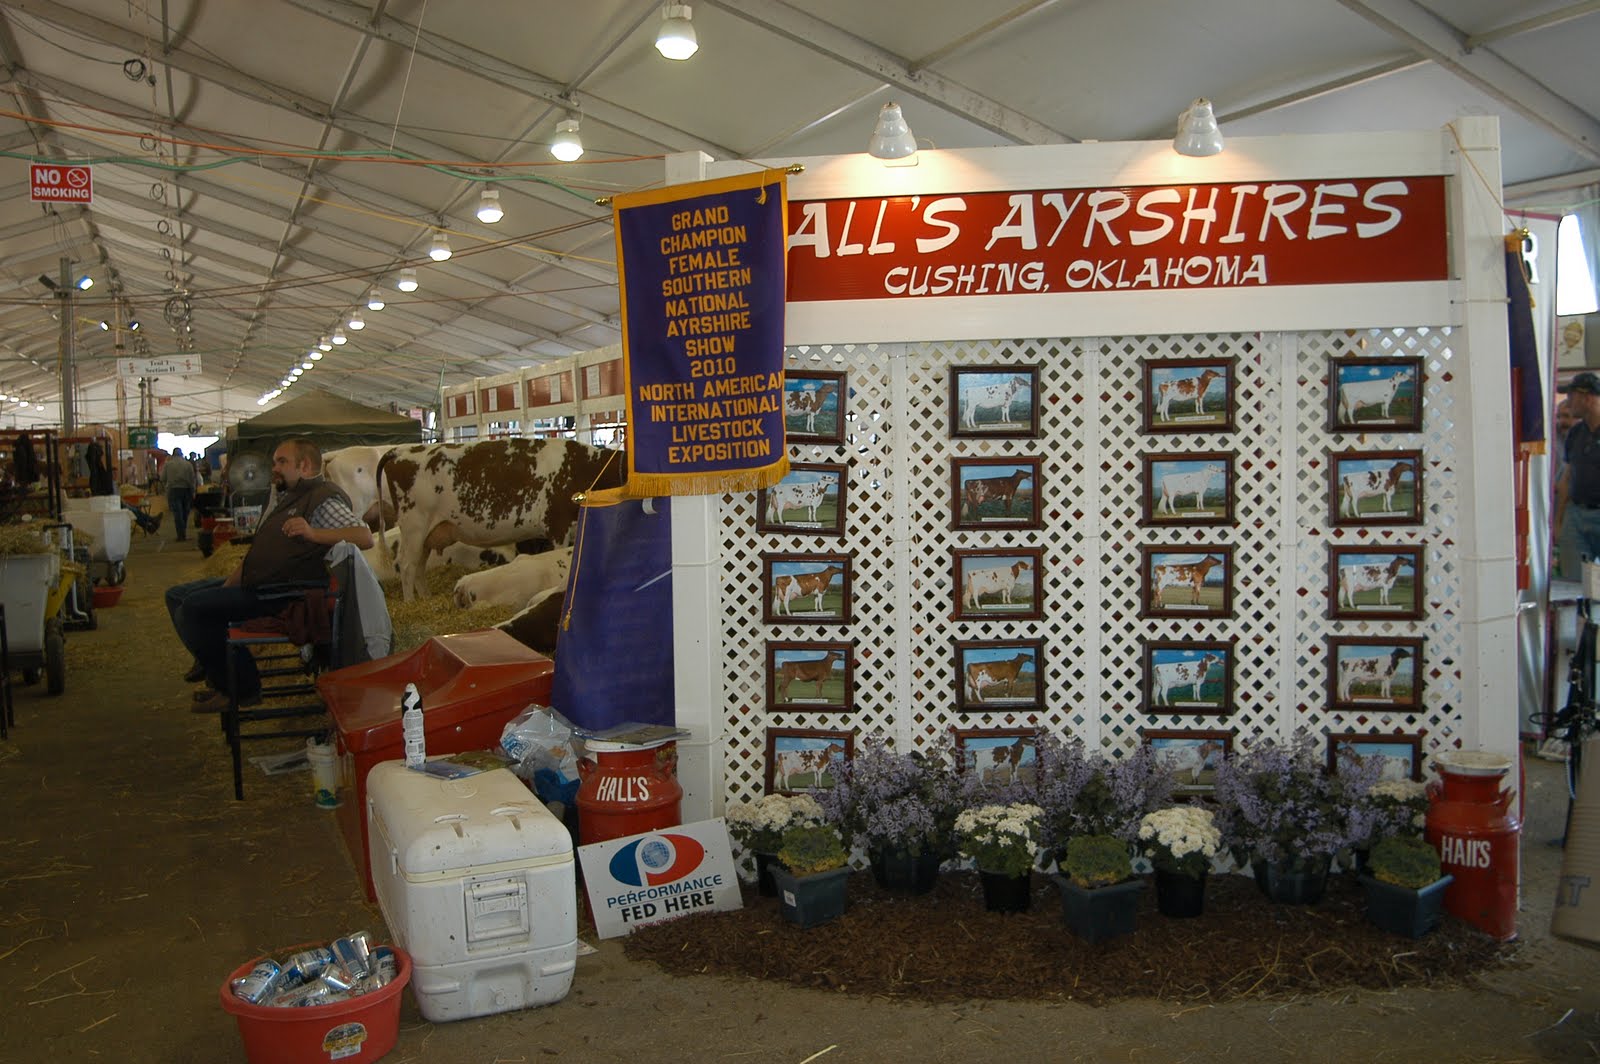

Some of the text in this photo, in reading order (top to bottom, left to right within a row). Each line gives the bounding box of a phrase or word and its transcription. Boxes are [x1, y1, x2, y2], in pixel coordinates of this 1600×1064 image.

[35, 169, 61, 185] NO
[33, 187, 89, 199] SMOKING
[672, 206, 729, 231] GRAND
[788, 181, 1409, 258] ALL'S AYRSHIRES
[660, 226, 747, 255] CHAMPION
[669, 248, 740, 275] FEMALE
[884, 254, 1268, 296] CUSHING, OKLAHOMA
[662, 267, 751, 297] SOUTHERN
[665, 291, 749, 318] NATIONAL
[667, 311, 751, 338] AYRSHIRE
[686, 335, 735, 357] SHOW
[690, 356, 736, 378] 2010
[639, 370, 785, 402] NORTH AMERICAN
[651, 394, 779, 423] INTERNATIONAL
[672, 418, 764, 443] LIVESTOCK
[668, 438, 770, 464] EXPOSITION
[596, 776, 649, 802] HALL'S
[607, 874, 723, 908] PERFORMANCE
[621, 903, 657, 923] FED
[664, 890, 714, 914] HERE
